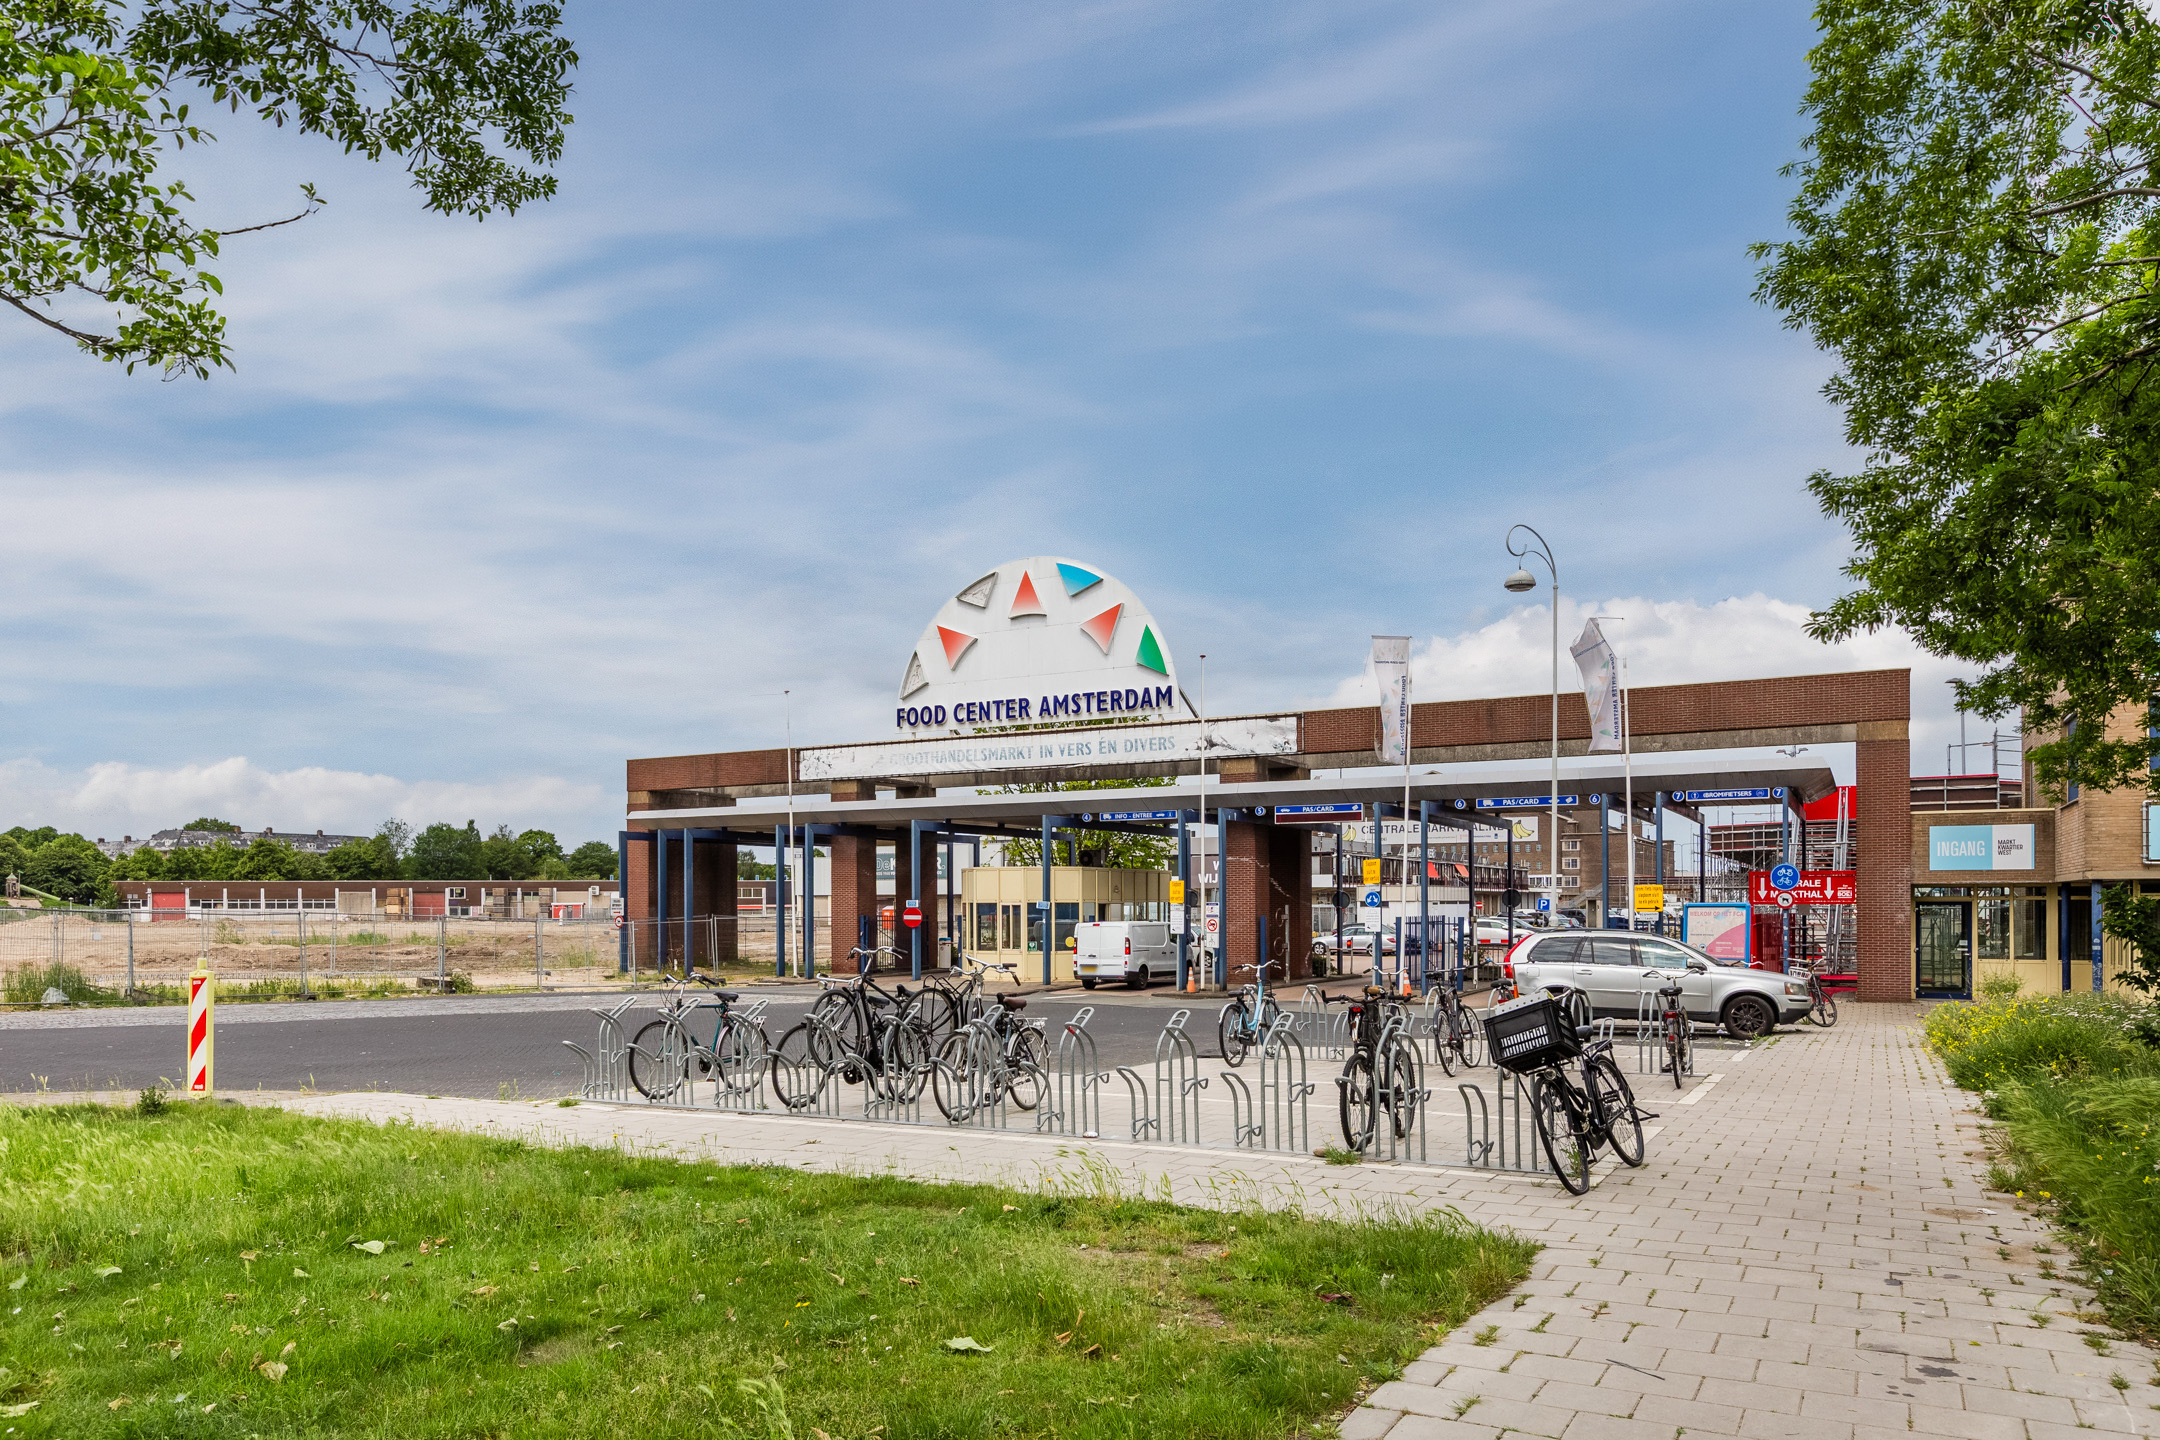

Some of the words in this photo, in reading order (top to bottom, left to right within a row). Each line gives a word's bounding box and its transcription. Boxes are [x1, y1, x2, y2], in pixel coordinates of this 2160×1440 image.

[896, 704, 947, 728] FOOD
[953, 697, 1031, 723] CENTER
[1039, 685, 1173, 717] AMSTERDAM
[1040, 744, 1053, 759] IN
[1059, 742, 1092, 758] VERS
[1098, 737, 1117, 755] ÉN
[1124, 736, 1176, 753] DIVERS
[1502, 798, 1539, 806] PAS/CARD
[1937, 840, 1985, 857] INGANG
[1770, 890, 1823, 898] MKTHAL
[1540, 900, 1548, 909] P
